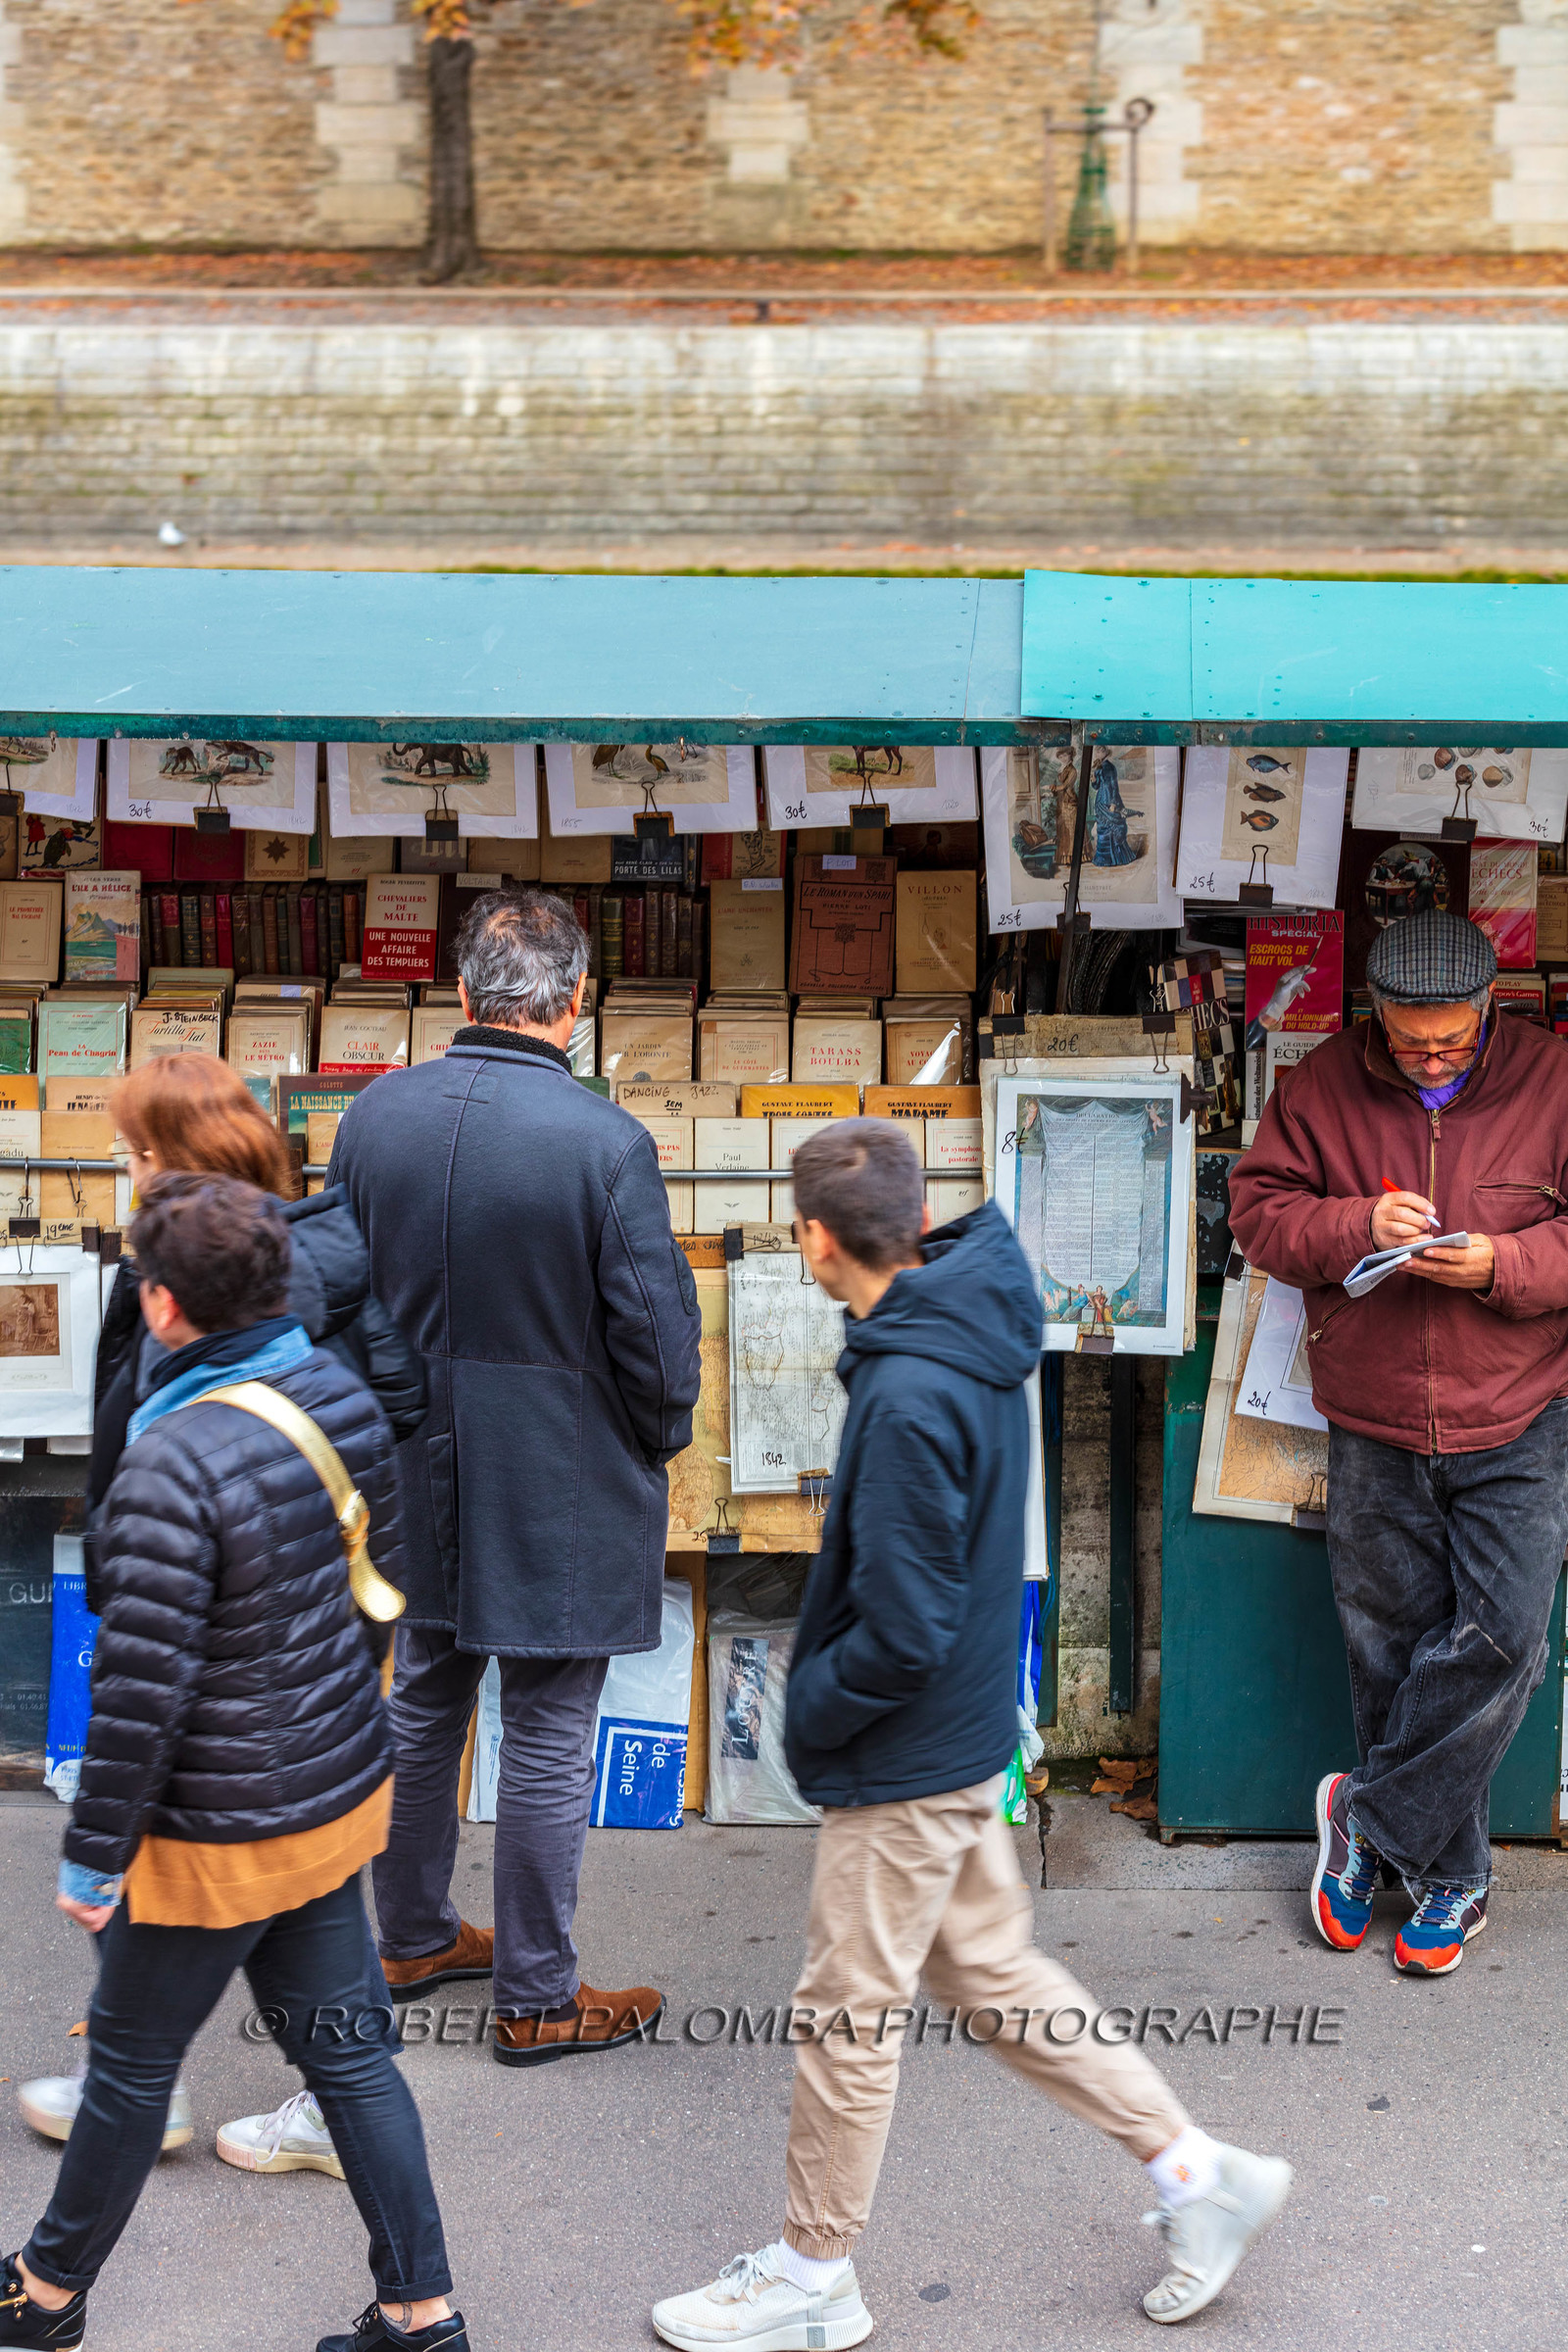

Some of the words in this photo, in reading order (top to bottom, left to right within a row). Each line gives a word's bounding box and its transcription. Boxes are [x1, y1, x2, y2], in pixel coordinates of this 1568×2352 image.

[128, 801, 152, 819] 30€
[785, 800, 807, 819] 30€
[614, 865, 638, 875] PORTE
[642, 865, 657, 874] DES
[661, 865, 683, 875] LILAS
[1471, 868, 1522, 879] ECHECS
[1188, 871, 1214, 893] 25€
[101, 883, 131, 893] HÉLICE
[804, 886, 817, 897] LE
[817, 887, 848, 899] ROMAN
[907, 885, 963, 895] VILLON
[383, 912, 418, 922] MALTE
[996, 908, 1021, 927] 25€
[1248, 915, 1343, 932] HISTORIA
[368, 932, 386, 942] UNE
[390, 933, 431, 943] NOUVELLE
[381, 945, 416, 955] AFFAIRE
[1249, 944, 1294, 956] ESCROCS
[1295, 945, 1310, 956] DE
[368, 956, 383, 966] DES
[385, 957, 429, 968] TEMPLIERS
[1249, 955, 1276, 965] HAUT
[1276, 956, 1295, 966] VOL
[1284, 1013, 1340, 1023] MILLIONNAIRES
[347, 1041, 379, 1051] CLAIR
[1047, 1033, 1079, 1052] 20€
[84, 1049, 117, 1058] Chagrin
[342, 1051, 385, 1061] OBSCUR
[809, 1047, 862, 1055] TARASS
[1273, 1045, 1307, 1059] ÉCH
[809, 1057, 860, 1066] BOULBA
[290, 1096, 300, 1109] LA
[301, 1096, 342, 1110] NAISSANCE
[663, 1100, 683, 1109] SEM
[891, 1108, 950, 1118] MADAME
[1000, 1126, 1027, 1154] 8€
[951, 1146, 981, 1154] symphon
[722, 1152, 741, 1162] Paul
[948, 1155, 978, 1164] pastorale
[714, 1162, 750, 1171] Verlaine
[1246, 1390, 1271, 1416] 20€
[760, 1452, 786, 1468] 1842
[64, 1581, 86, 1591] LIBR
[732, 1650, 759, 1744] LOUVRE
[653, 1743, 671, 1769] de
[619, 1739, 643, 1796] Seine
